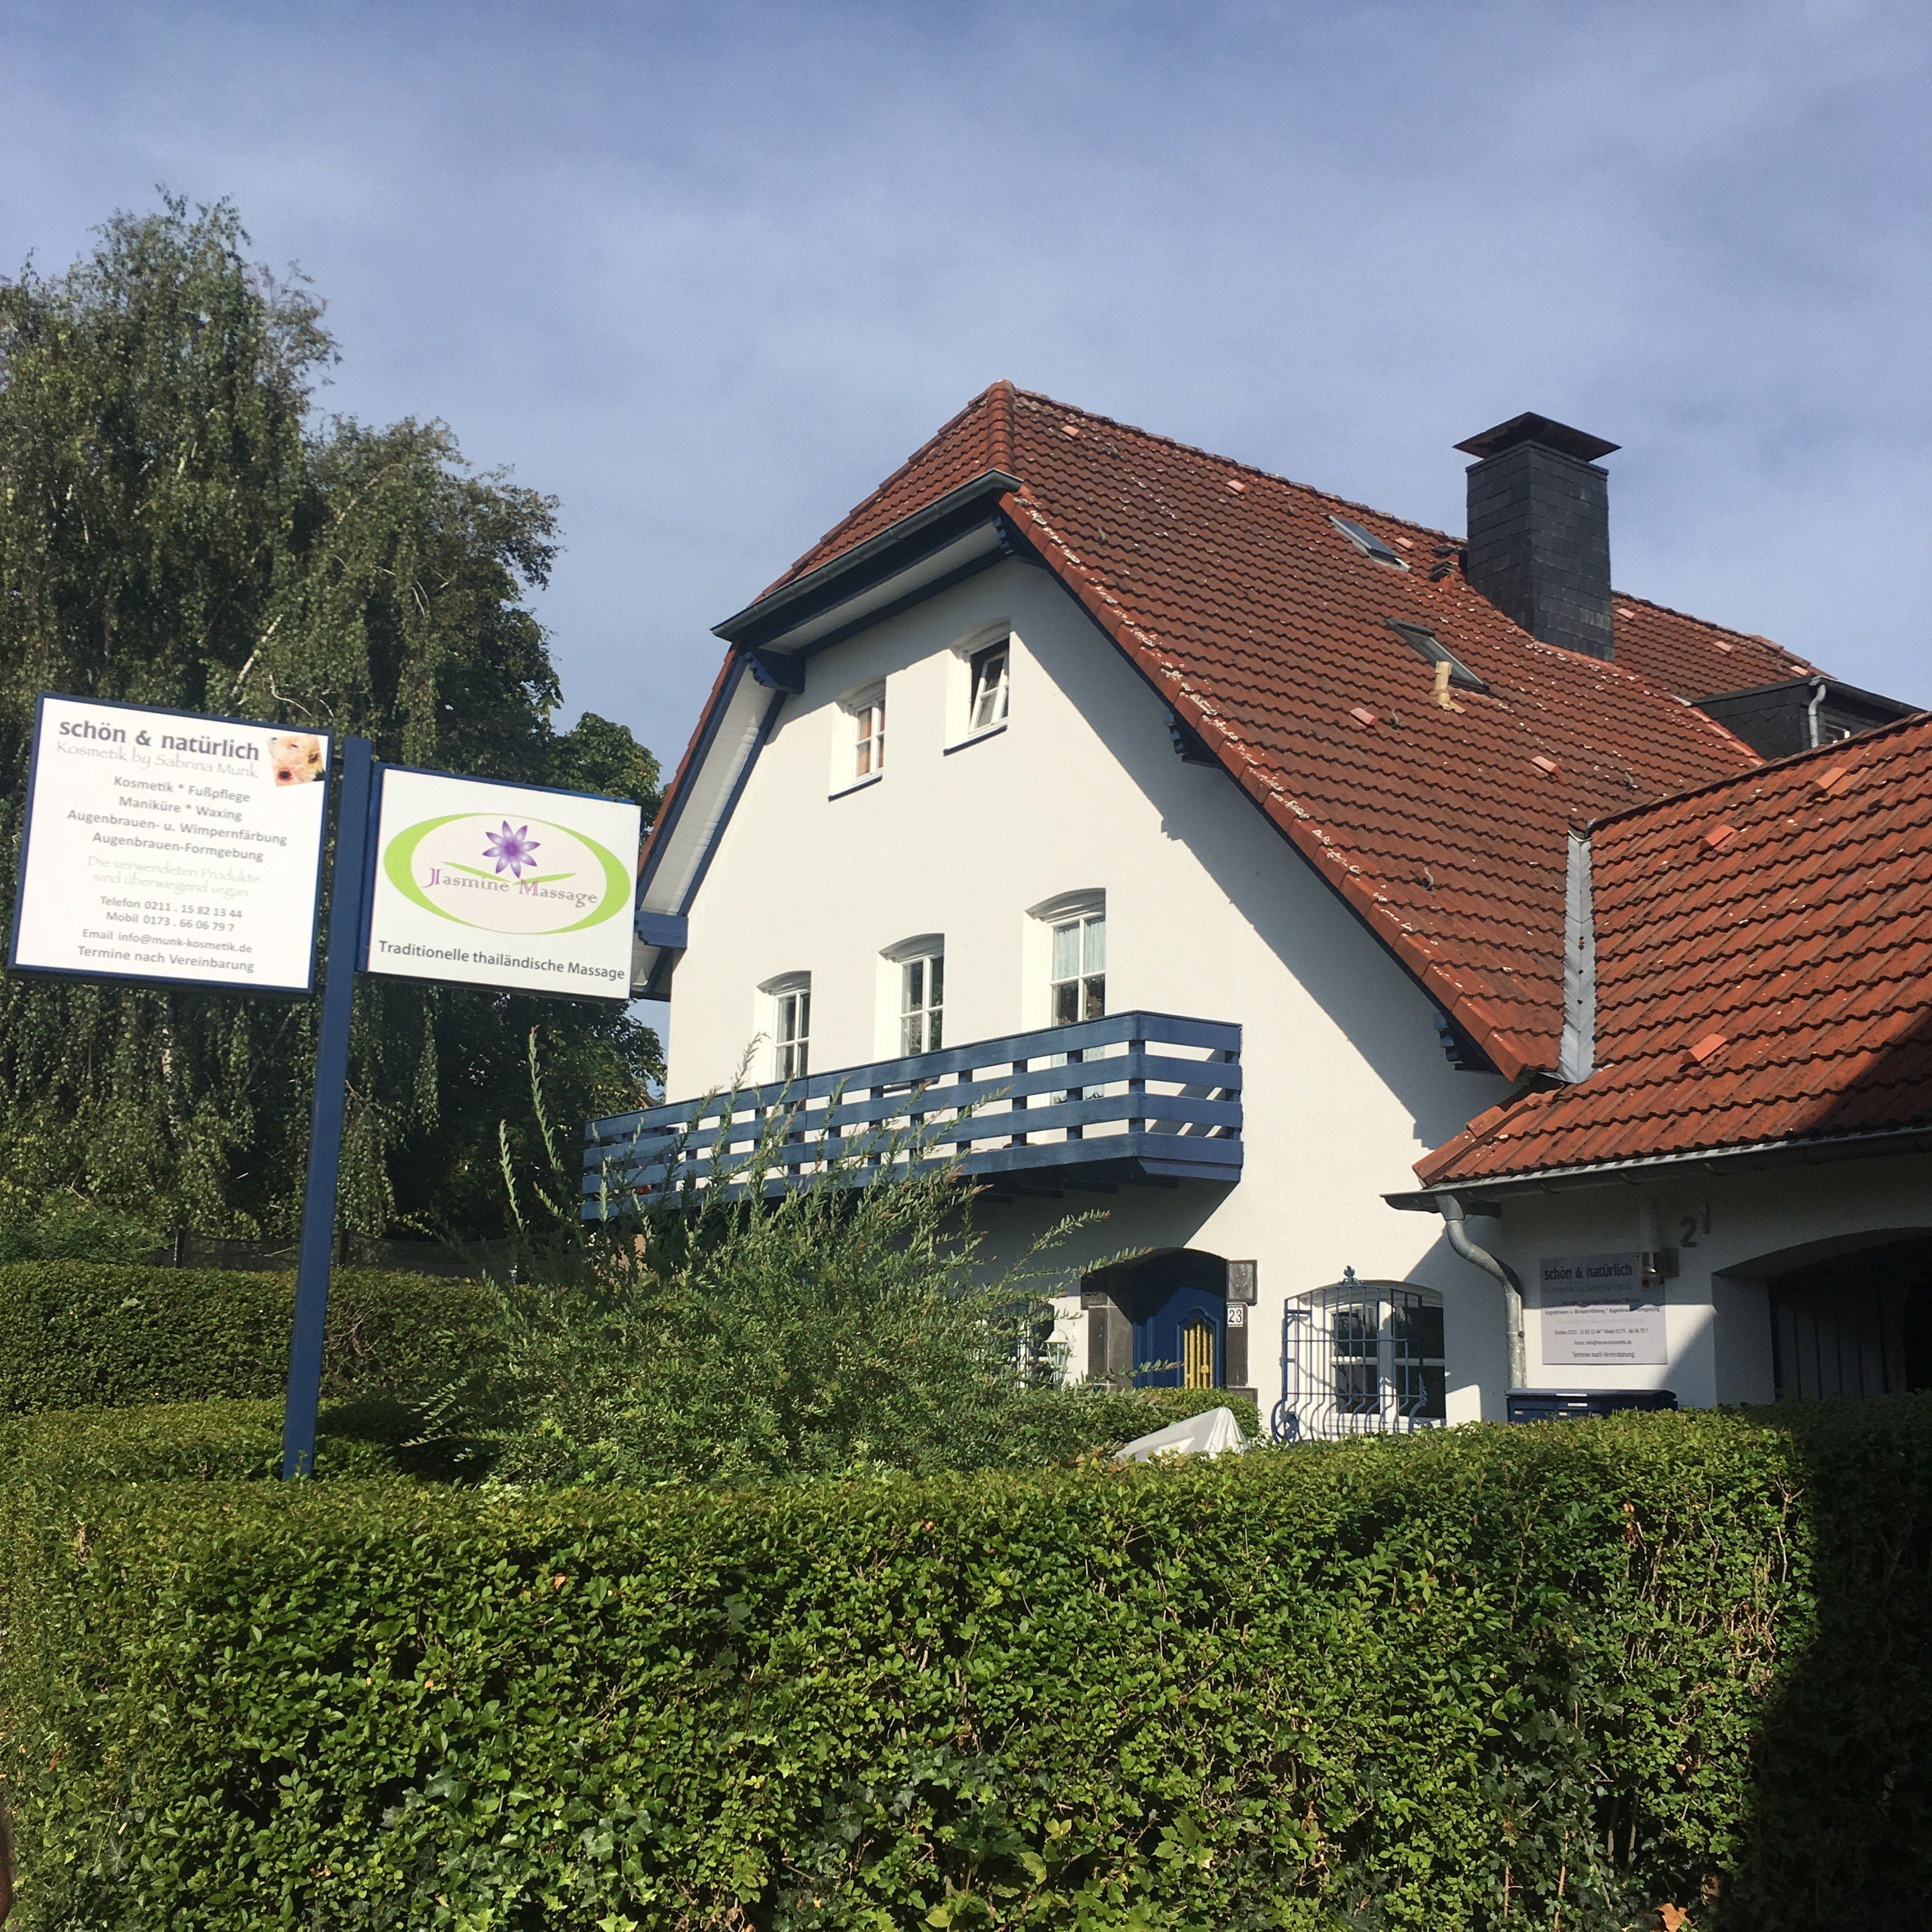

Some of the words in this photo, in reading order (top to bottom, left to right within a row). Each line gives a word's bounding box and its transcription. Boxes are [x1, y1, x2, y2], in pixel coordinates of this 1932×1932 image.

[59, 720, 125, 743] schön
[135, 730, 152, 746] &
[161, 735, 260, 761] natürlich
[57, 741, 127, 761] Kosmetik
[131, 746, 151, 770] by
[154, 752, 213, 772] Sabrina
[217, 762, 258, 778] Munk
[114, 776, 174, 793] Kosmetik
[188, 786, 251, 804] Fußpflege
[118, 795, 181, 813] Maniküre
[195, 805, 243, 823] Waxing
[67, 809, 160, 829] Augenbrauen-
[164, 823, 175, 832] u.
[180, 822, 288, 846] Wimpernfärbung
[91, 832, 264, 863] Augenbrauen-Formgebung
[88, 855, 111, 868] Die
[113, 861, 198, 877] verwendeten
[201, 867, 260, 884] Produkte
[93, 870, 121, 884] sind
[124, 872, 208, 895] überwiegend
[100, 896, 141, 909] Telefon
[144, 900, 171, 912] 0211
[181, 904, 195, 914] 15
[197, 906, 211, 915] 82
[213, 908, 226, 917] 13
[229, 909, 242, 918] 44
[518, 879, 598, 908] Massage
[106, 912, 140, 923] Mobil
[143, 915, 171, 926] 0173
[179, 918, 193, 928] 66
[195, 920, 210, 930] 06
[212, 921, 226, 931] 79
[228, 923, 235, 932] 7
[82, 928, 114, 940] Email
[118, 931, 253, 953] info@munk-kosmetik.de
[77, 946, 131, 960] Termine
[134, 952, 165, 963] nach
[168, 953, 255, 974] Vereinbarung
[379, 940, 469, 963] Traditionelle
[472, 951, 565, 974] thailändische
[568, 961, 626, 981] Massage
[1680, 1201, 1712, 1248] 21
[1544, 1266, 1572, 1281] schön
[1576, 1266, 1583, 1278] &
[1586, 1262, 1632, 1278] natürlich
[1229, 1309, 1242, 1323] 23
